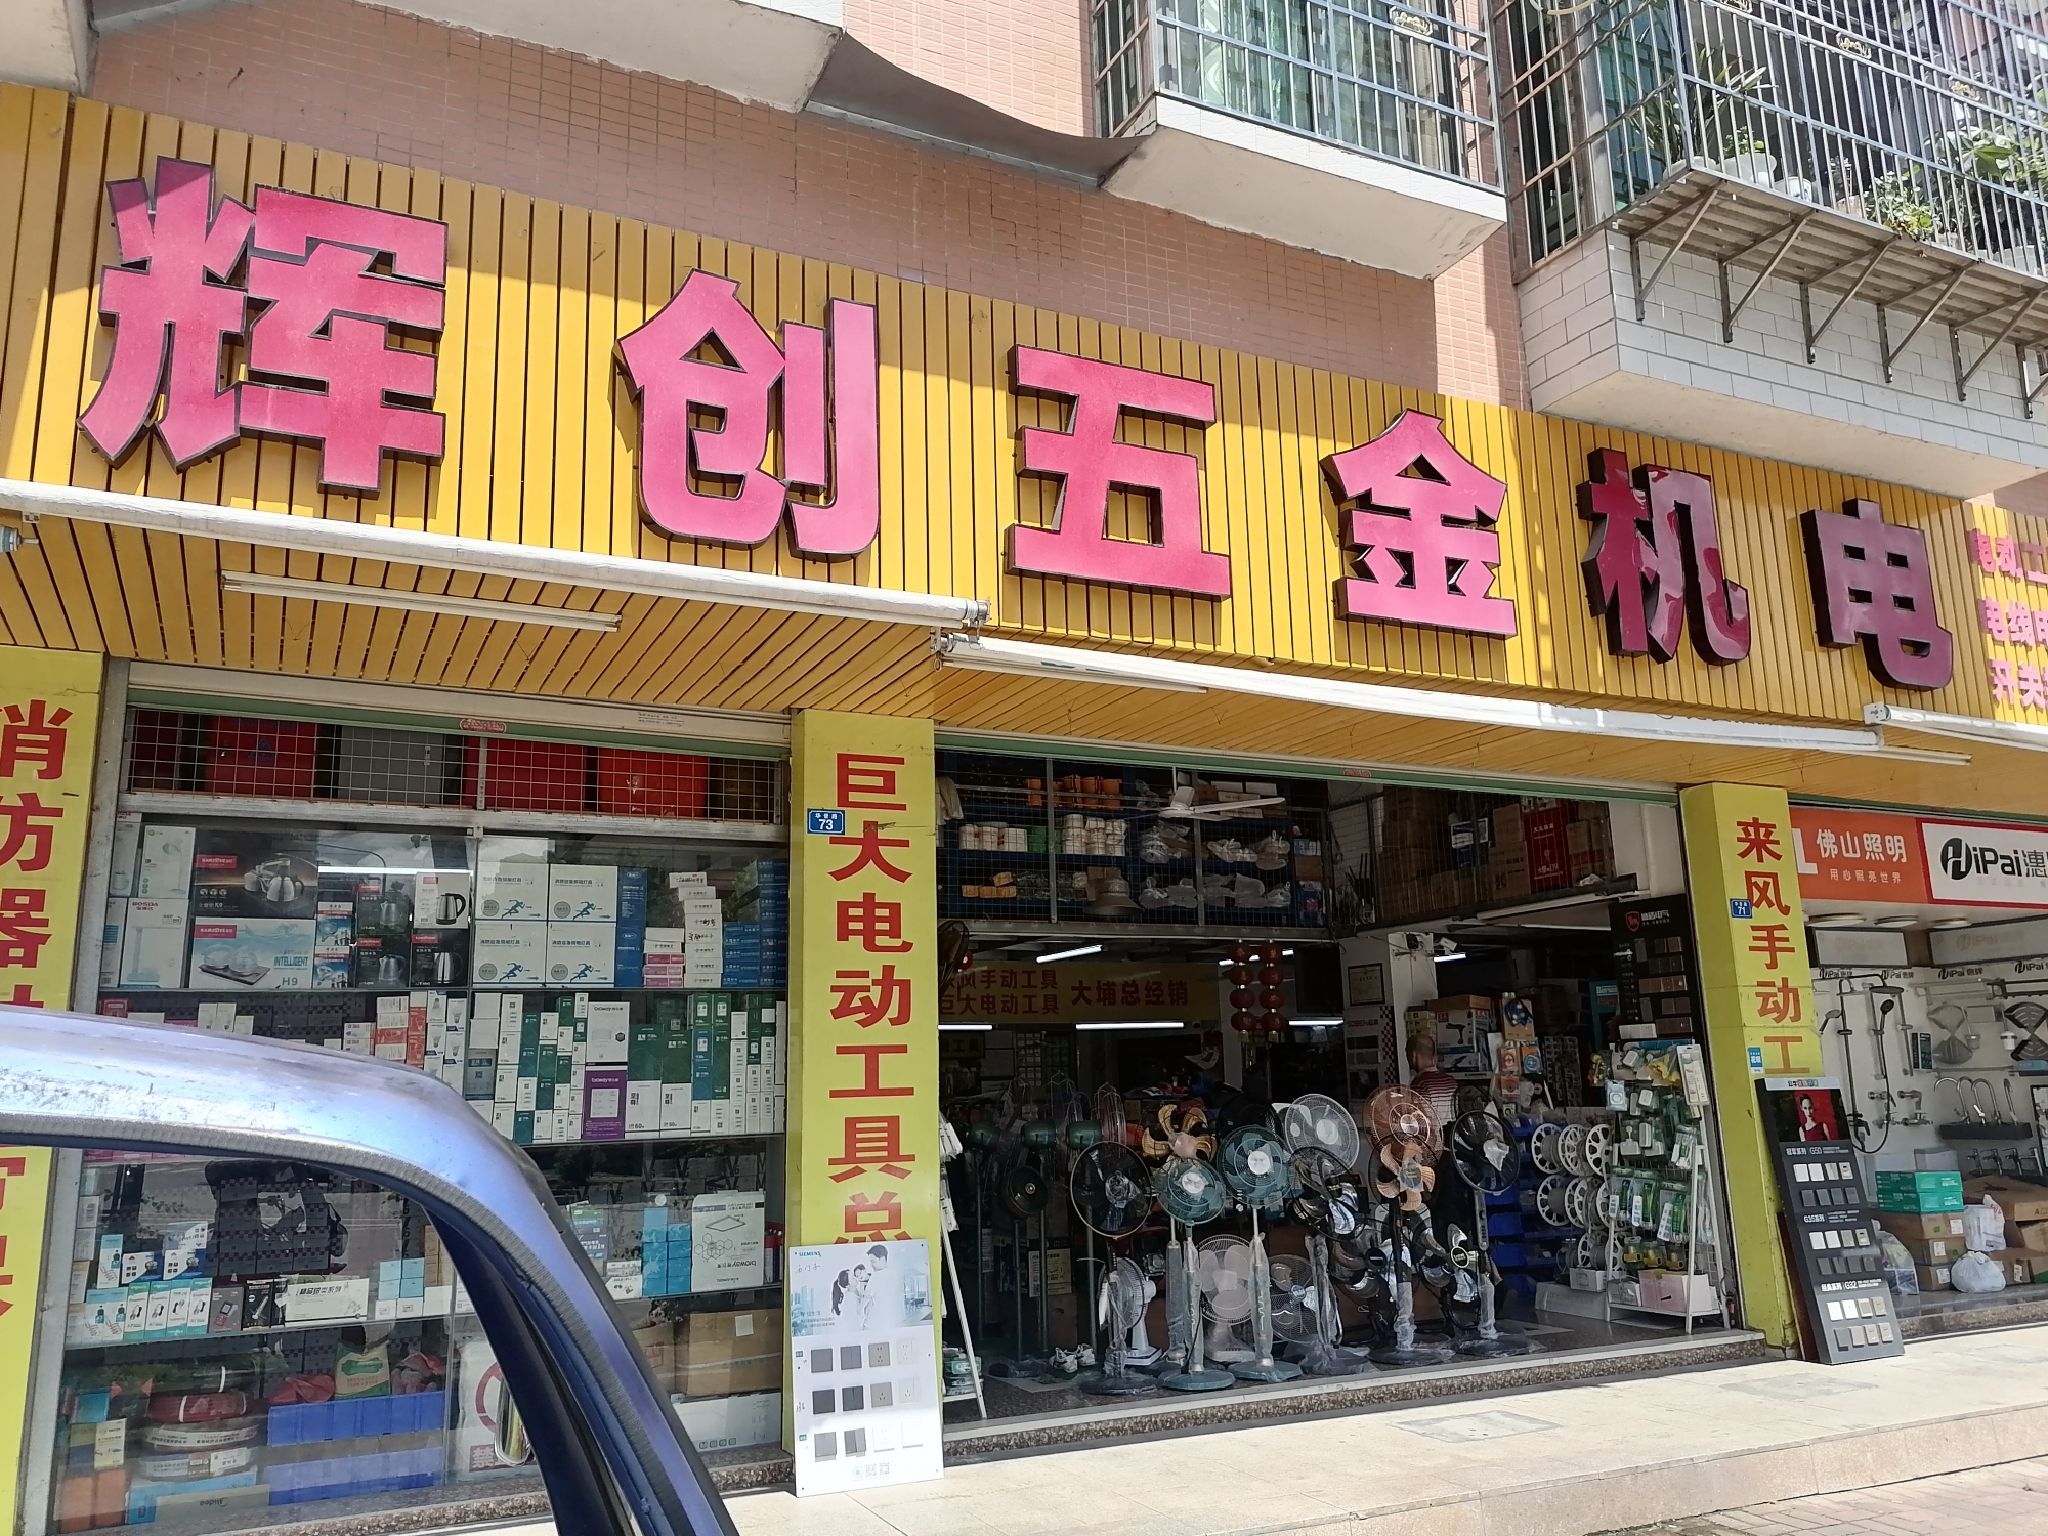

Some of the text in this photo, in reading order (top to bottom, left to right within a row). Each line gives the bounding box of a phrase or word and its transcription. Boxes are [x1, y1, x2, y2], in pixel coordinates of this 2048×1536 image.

[77, 156, 1954, 692] 辉创五金机电
[1988, 659, 2048, 712] 开关
[818, 819, 834, 830] 73
[1816, 828, 1908, 863] 佛山照明
[1829, 867, 1903, 885] 用心照亮世界
[1737, 906, 1746, 915] 71
[282, 976, 298, 986] H9
[939, 993, 1060, 1015] 巨大电动工具
[1070, 980, 1189, 1007] 大埔总经销
